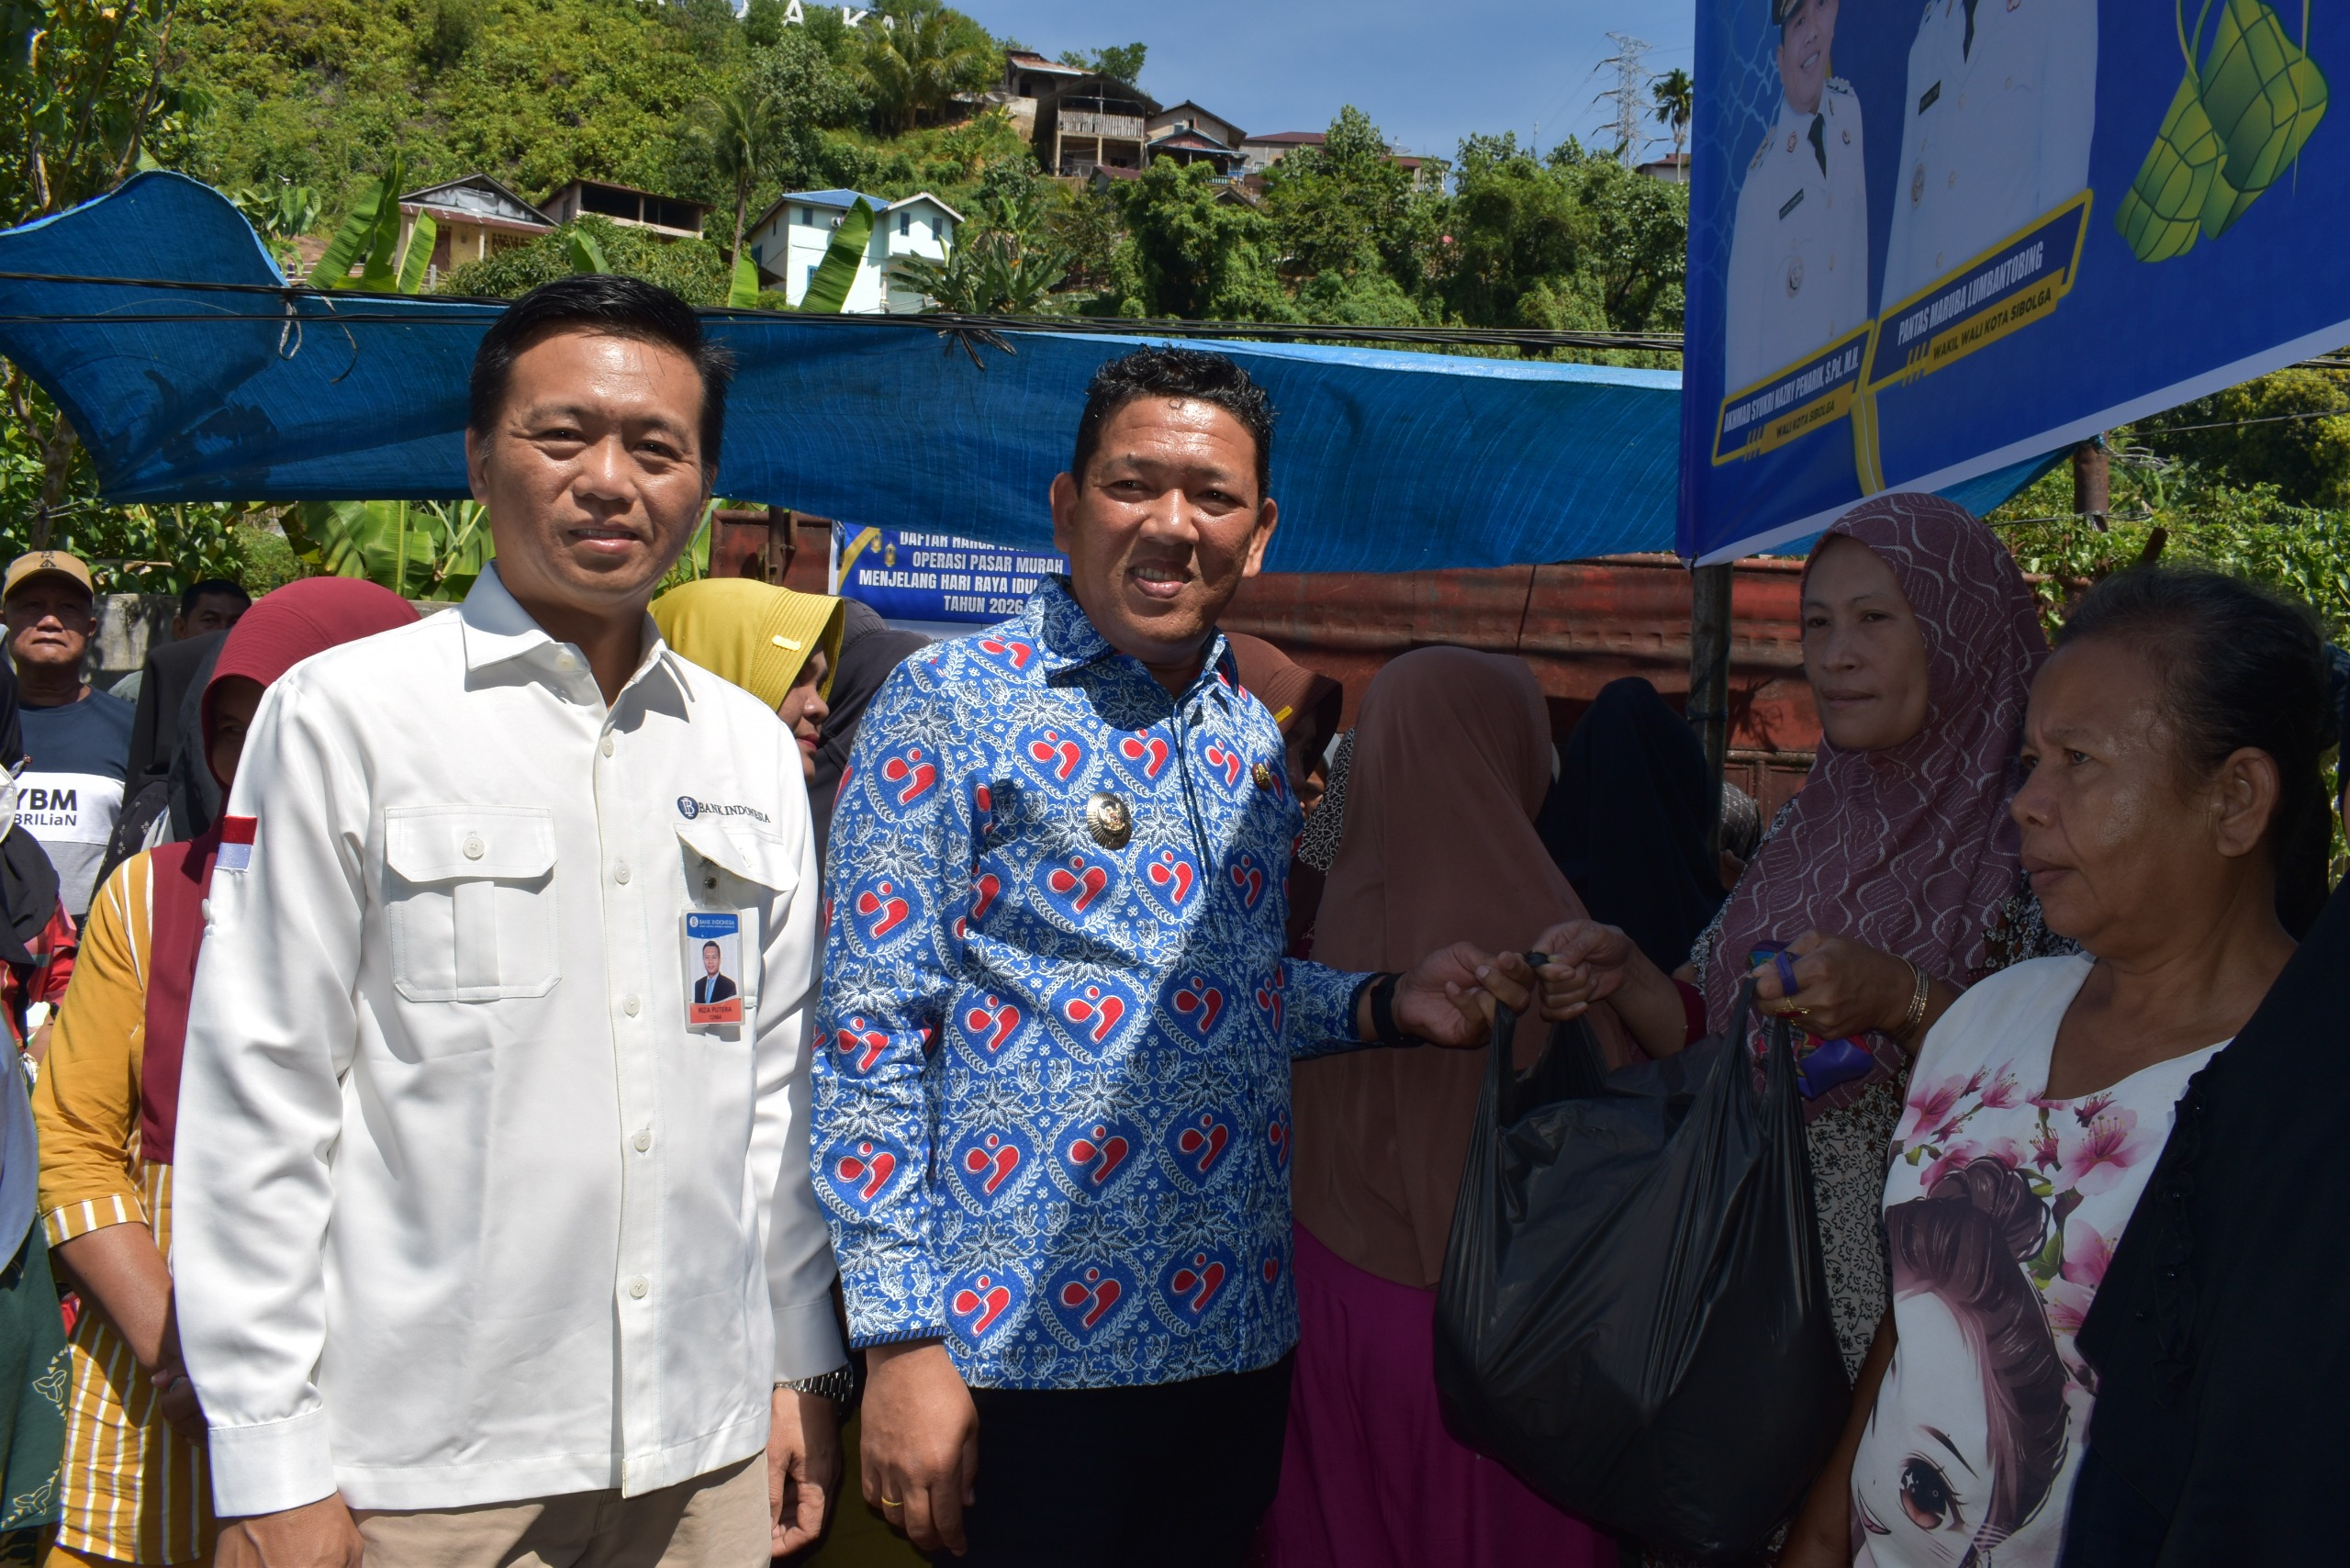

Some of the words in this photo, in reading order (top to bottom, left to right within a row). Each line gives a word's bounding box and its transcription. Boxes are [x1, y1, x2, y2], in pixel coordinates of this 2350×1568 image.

[1897, 307, 1930, 346] PANTAS
[1930, 285, 1966, 329] MARUBA
[1967, 241, 2043, 308] LUMBANTOBING
[1933, 336, 1959, 360] WAKIL
[1961, 322, 1983, 346] WALI
[1984, 309, 2009, 334] KOTA
[2010, 287, 2051, 320] SIBOLGA
[1723, 402, 1751, 433] AKHMAD
[1751, 390, 1774, 421] SYUKRI
[1774, 378, 1796, 409] NAZRY
[1776, 422, 1795, 438] WALI
[1792, 414, 1809, 431] KOTA
[1808, 399, 1835, 422] SIBOLGA
[912, 551, 967, 570] OPERASI
[969, 554, 1013, 573] PASAR
[1015, 556, 1064, 574] MURAH
[858, 569, 937, 589] MENJELANG
[940, 574, 971, 591] HARI
[974, 576, 1008, 593] RAYA
[944, 595, 986, 613] TAHUN
[989, 598, 1024, 615] 2026
[16, 789, 77, 812] YBM
[698, 801, 722, 815] BANK
[722, 805, 771, 823] INDONESIA
